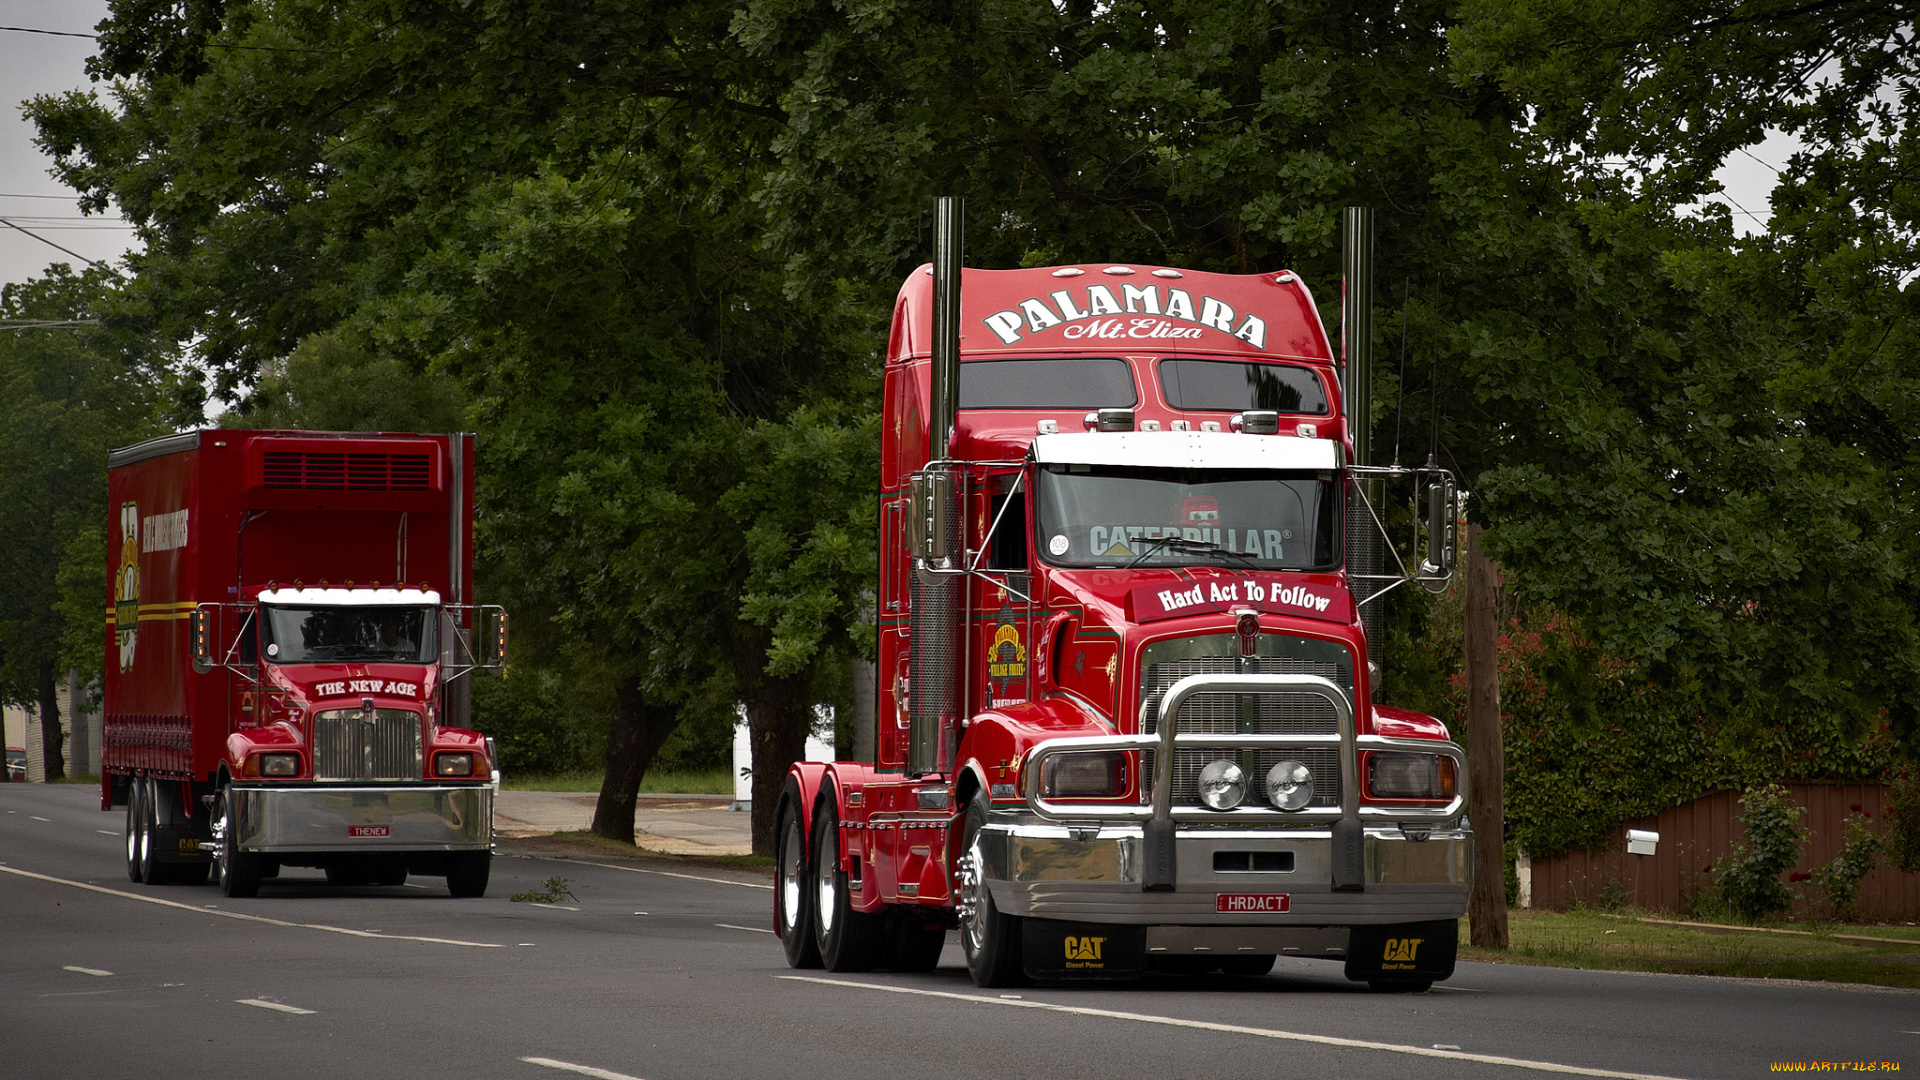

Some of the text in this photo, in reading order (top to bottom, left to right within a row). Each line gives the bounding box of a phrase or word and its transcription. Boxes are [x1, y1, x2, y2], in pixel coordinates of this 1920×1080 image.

[984, 283, 1267, 349] PALAMARA
[1052, 538, 1067, 549] 108
[1157, 580, 1331, 612] Hard Act To Follow
[315, 680, 417, 697] THE NEW AGE
[355, 827, 386, 836] THENEW
[1228, 896, 1284, 910] HRDACT
[1066, 961, 1104, 969] Diesel Power
